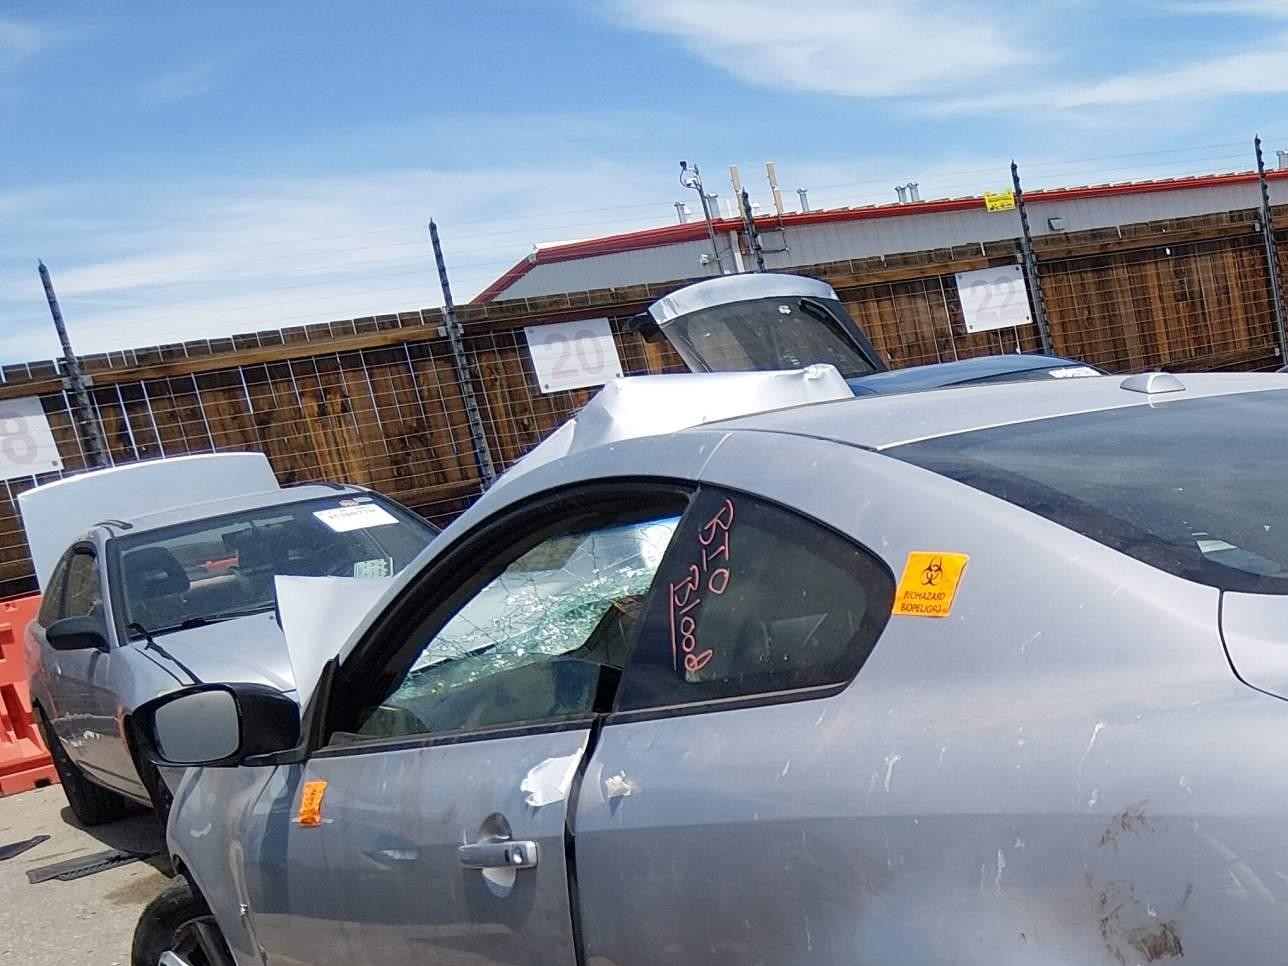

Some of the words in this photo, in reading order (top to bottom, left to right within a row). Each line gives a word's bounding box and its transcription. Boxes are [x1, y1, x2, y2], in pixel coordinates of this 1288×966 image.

[970, 276, 1025, 322] 22
[543, 328, 605, 380] 20
[900, 603, 942, 613] BIOPELIGRO
[903, 591, 945, 601] BIOHAZARD
